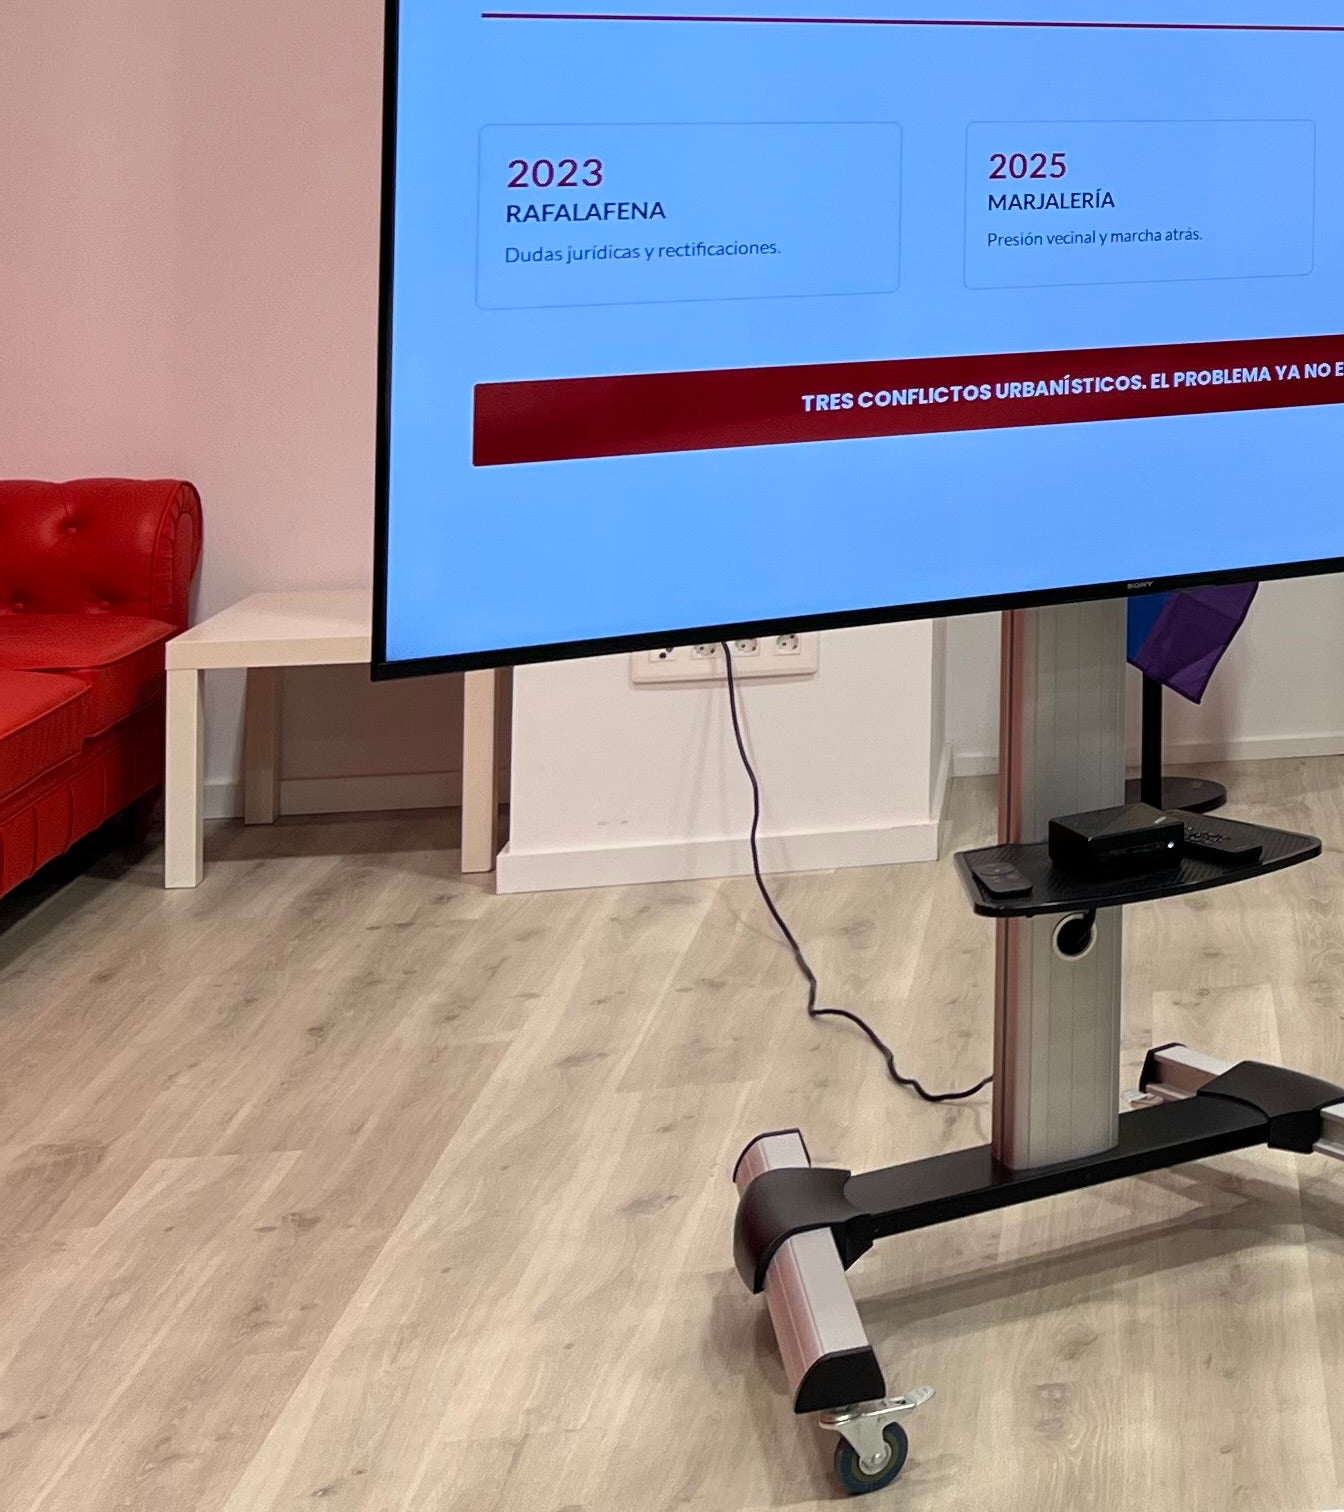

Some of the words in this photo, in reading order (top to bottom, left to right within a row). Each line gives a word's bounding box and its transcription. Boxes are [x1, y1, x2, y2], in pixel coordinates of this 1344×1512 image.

[507, 159, 603, 188] 2023
[989, 152, 1067, 179] 2025
[988, 189, 1115, 211] MARJALERÍA
[506, 202, 666, 223] RAFALAFENA
[987, 232, 1043, 247] Presión
[1047, 230, 1095, 245] vecinal
[1100, 234, 1106, 246] y
[1111, 229, 1161, 243] marcha
[1165, 227, 1203, 241] atrás.
[505, 247, 563, 263] Dudas
[566, 245, 640, 264] jurídicas
[646, 248, 655, 261] y
[658, 241, 782, 257] rectificaciones.
[801, 392, 854, 412] TRES
[858, 384, 991, 408] CONFLICTOS
[996, 374, 1147, 399] URBANÍSTICOS.
[1151, 373, 1170, 389] EL
[1174, 366, 1271, 388] PROBLEMA
[1275, 365, 1301, 381] YA
[1304, 362, 1331, 379] NO
